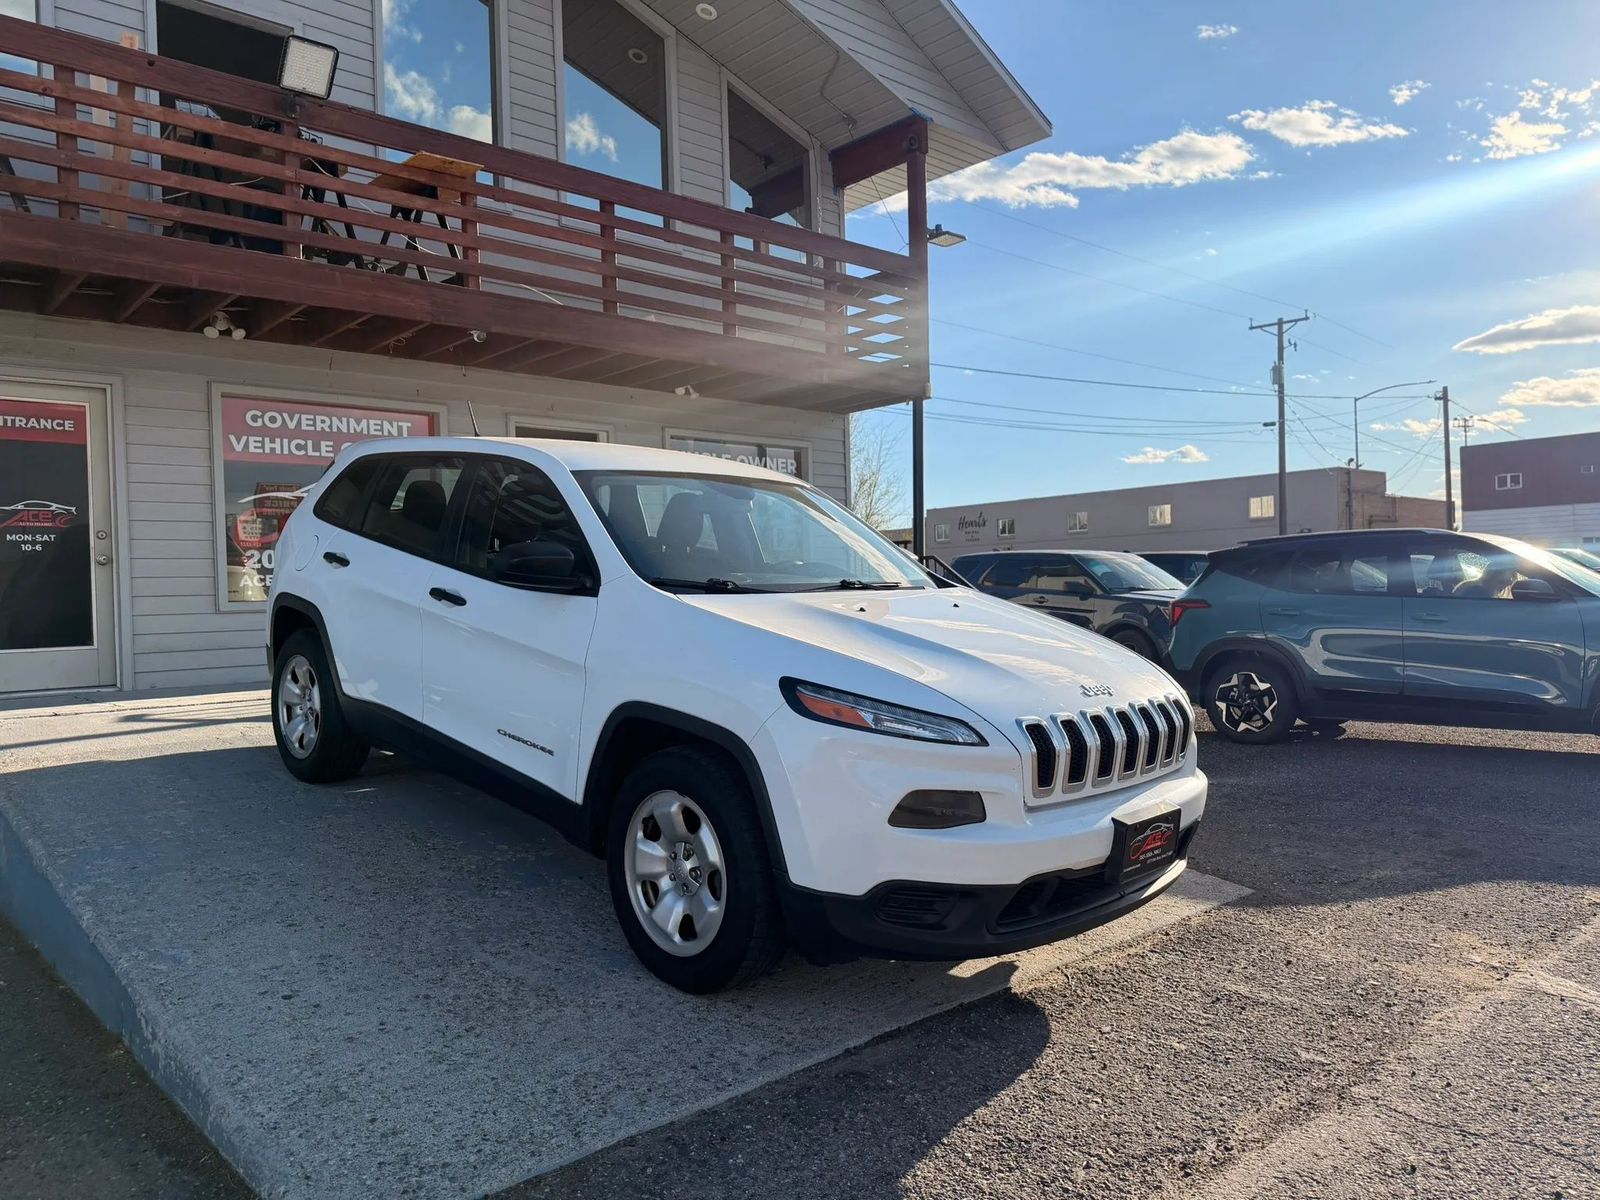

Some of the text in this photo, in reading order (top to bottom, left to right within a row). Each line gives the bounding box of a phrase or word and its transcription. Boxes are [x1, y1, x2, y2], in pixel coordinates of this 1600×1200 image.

[245, 410, 412, 437] GOVERNMENT
[228, 434, 334, 457] VEHICLE
[1080, 684, 1113, 697] Jeep
[497, 729, 554, 756] CHEROKEE
